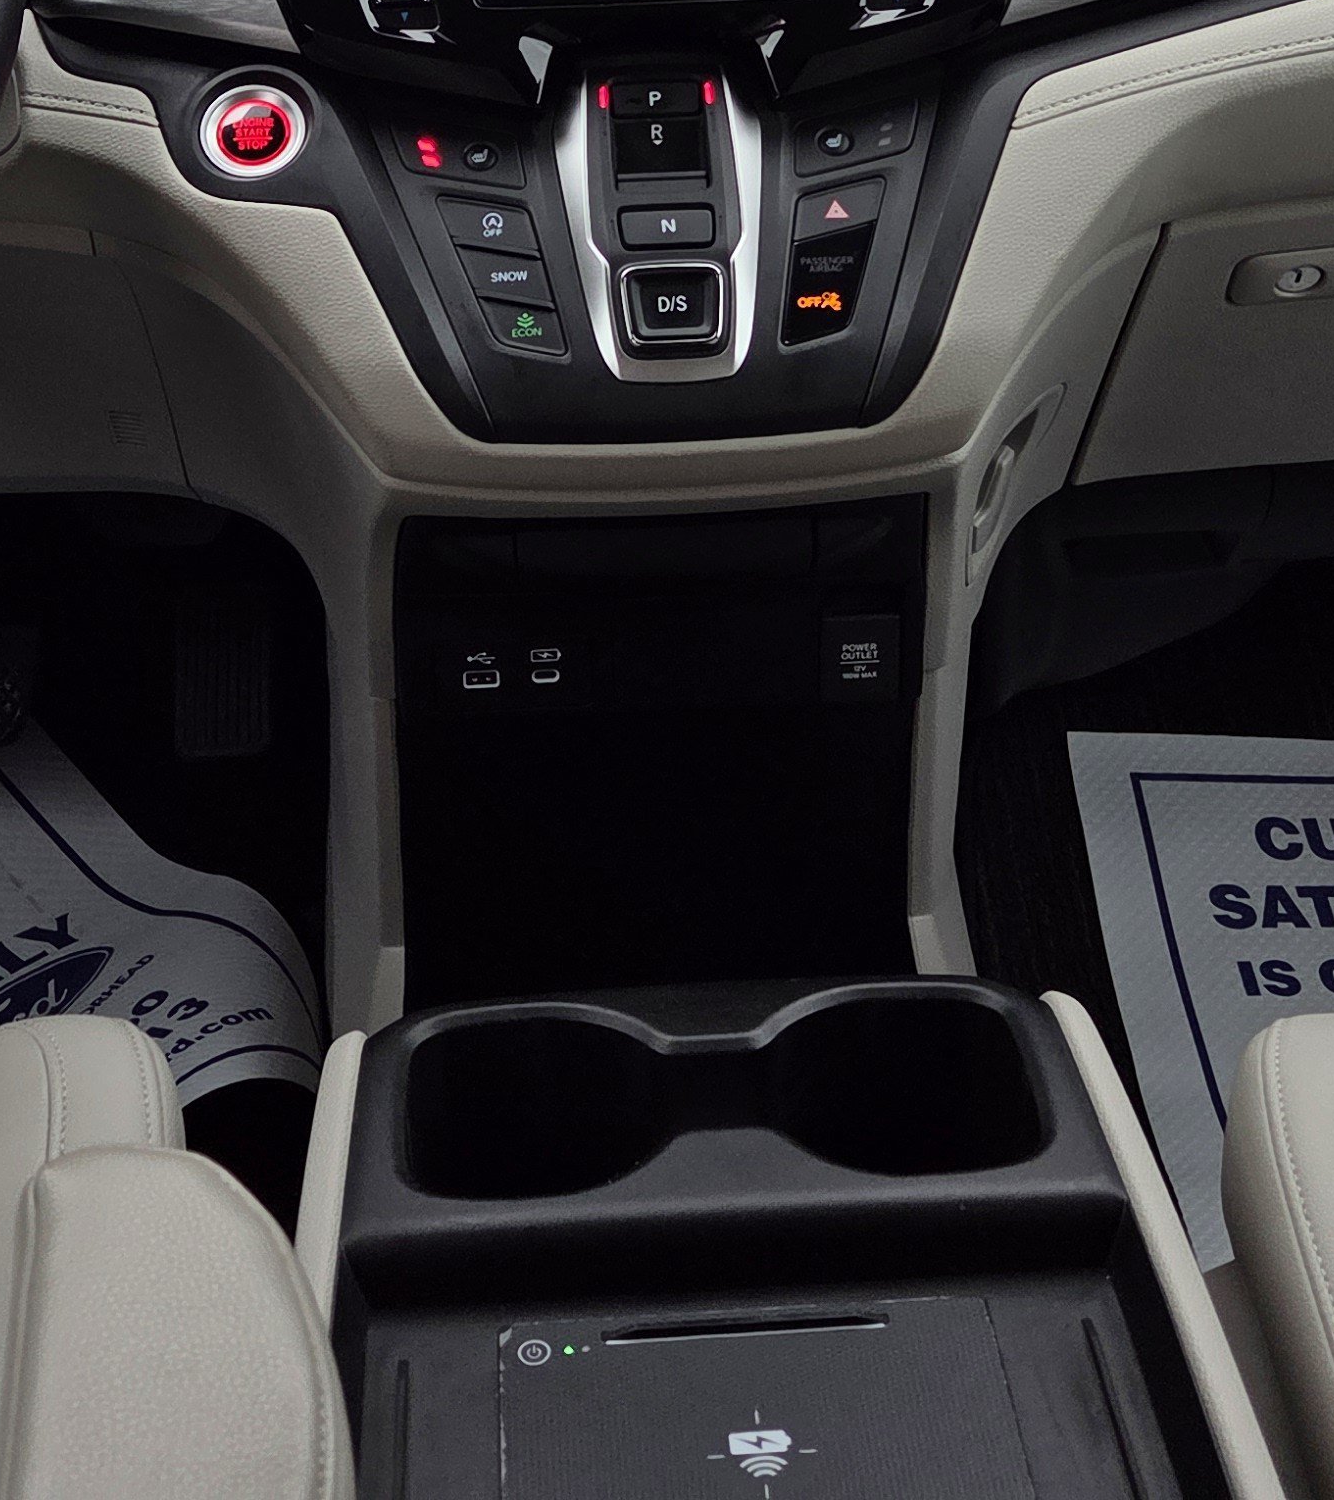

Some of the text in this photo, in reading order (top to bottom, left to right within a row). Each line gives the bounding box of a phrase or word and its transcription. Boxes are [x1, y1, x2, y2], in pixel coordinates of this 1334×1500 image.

[649, 91, 662, 106] P
[232, 117, 274, 129] ENGINE
[235, 128, 271, 137] START
[651, 124, 663, 140] R
[238, 140, 268, 151] STOP
[661, 218, 676, 233] N
[482, 228, 503, 238] OFF
[800, 255, 854, 265] PASSENGER
[490, 270, 528, 282] SNOW
[658, 295, 688, 313] D/S
[797, 296, 822, 308] OFF
[511, 327, 542, 338] ECON
[842, 643, 878, 651] POWER
[841, 650, 879, 660] OUTLET
[1238, 958, 1302, 997] IS
